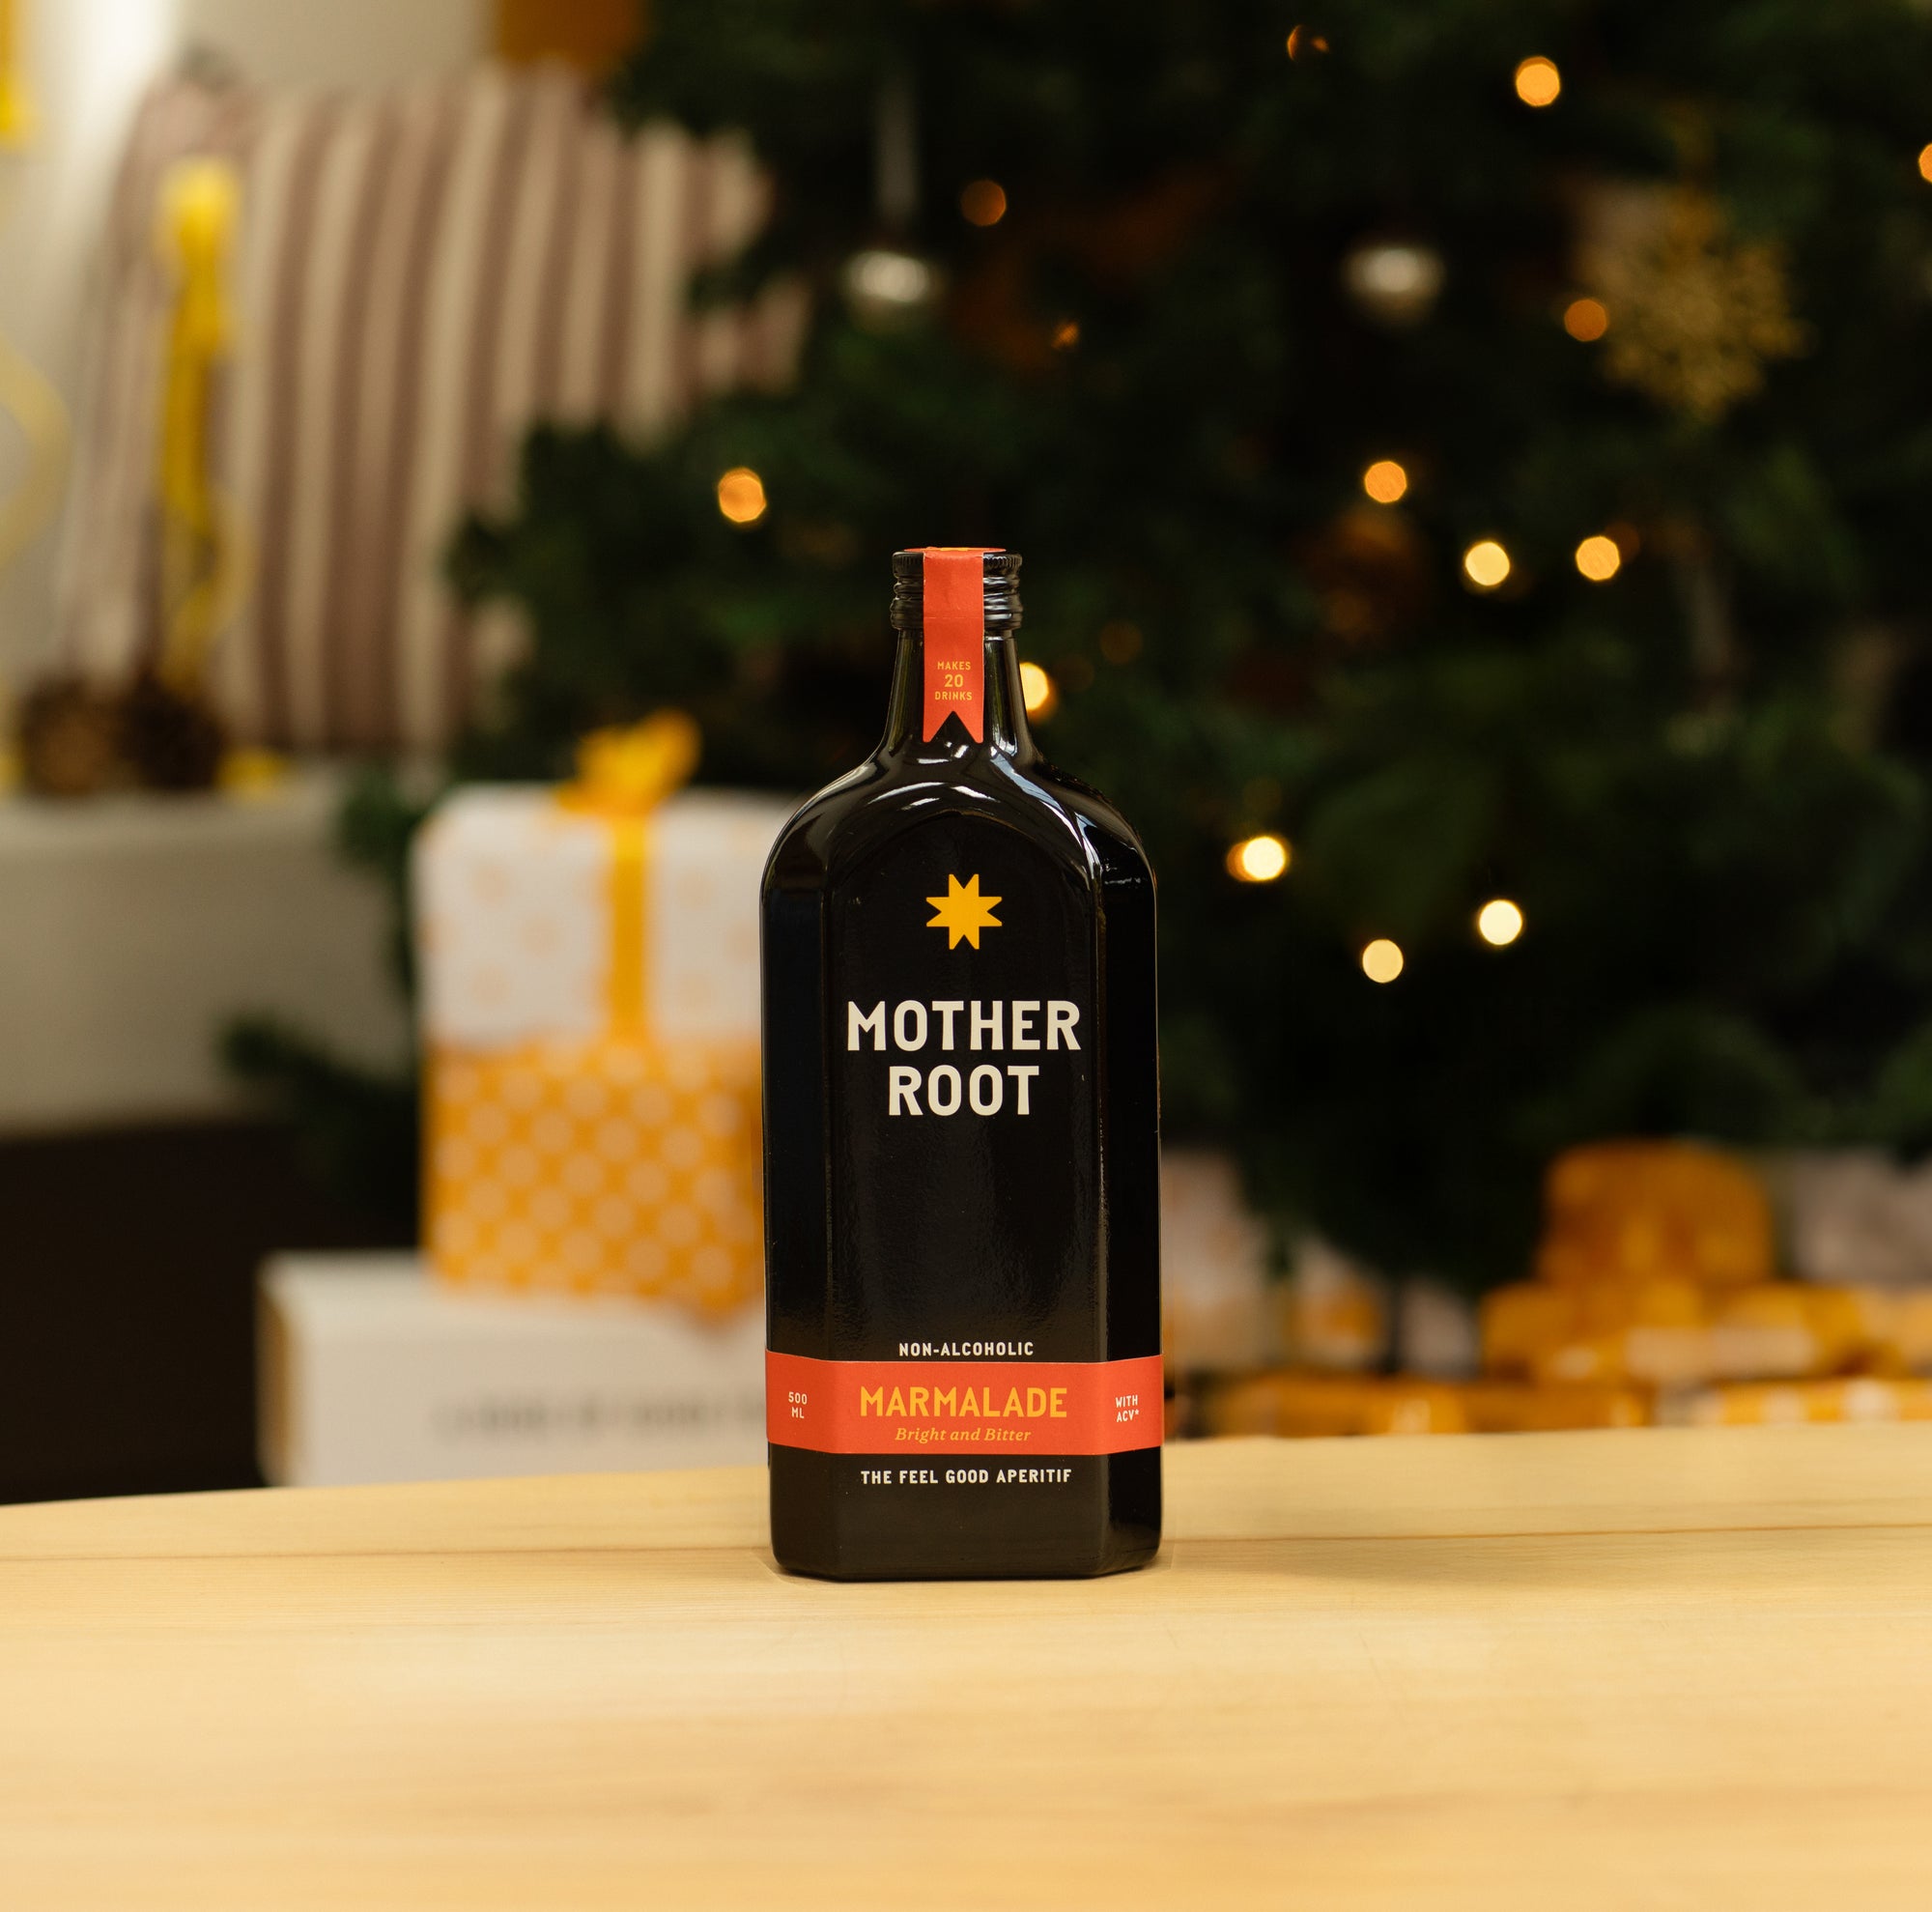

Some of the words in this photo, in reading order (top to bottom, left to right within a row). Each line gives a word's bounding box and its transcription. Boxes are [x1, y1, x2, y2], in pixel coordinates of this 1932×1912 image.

[937, 661, 971, 671] MAKES
[945, 674, 964, 688] 20
[934, 691, 973, 701] DRINKS
[847, 999, 1082, 1052] MOTHER
[889, 1064, 1039, 1117] ROOT
[898, 1341, 1035, 1357] NON-ALCOHOLIC
[788, 1391, 808, 1405] 500
[860, 1385, 1067, 1418] MARMALADE
[1115, 1394, 1139, 1408] WITH
[791, 1407, 805, 1419] ML
[895, 1427, 947, 1444] Bright
[950, 1427, 981, 1441] and
[983, 1427, 1032, 1441] Bitter
[861, 1470, 893, 1485] THE
[899, 1470, 939, 1484] FEEL
[945, 1469, 989, 1484] GOOD
[996, 1469, 1072, 1484] APERITIF
